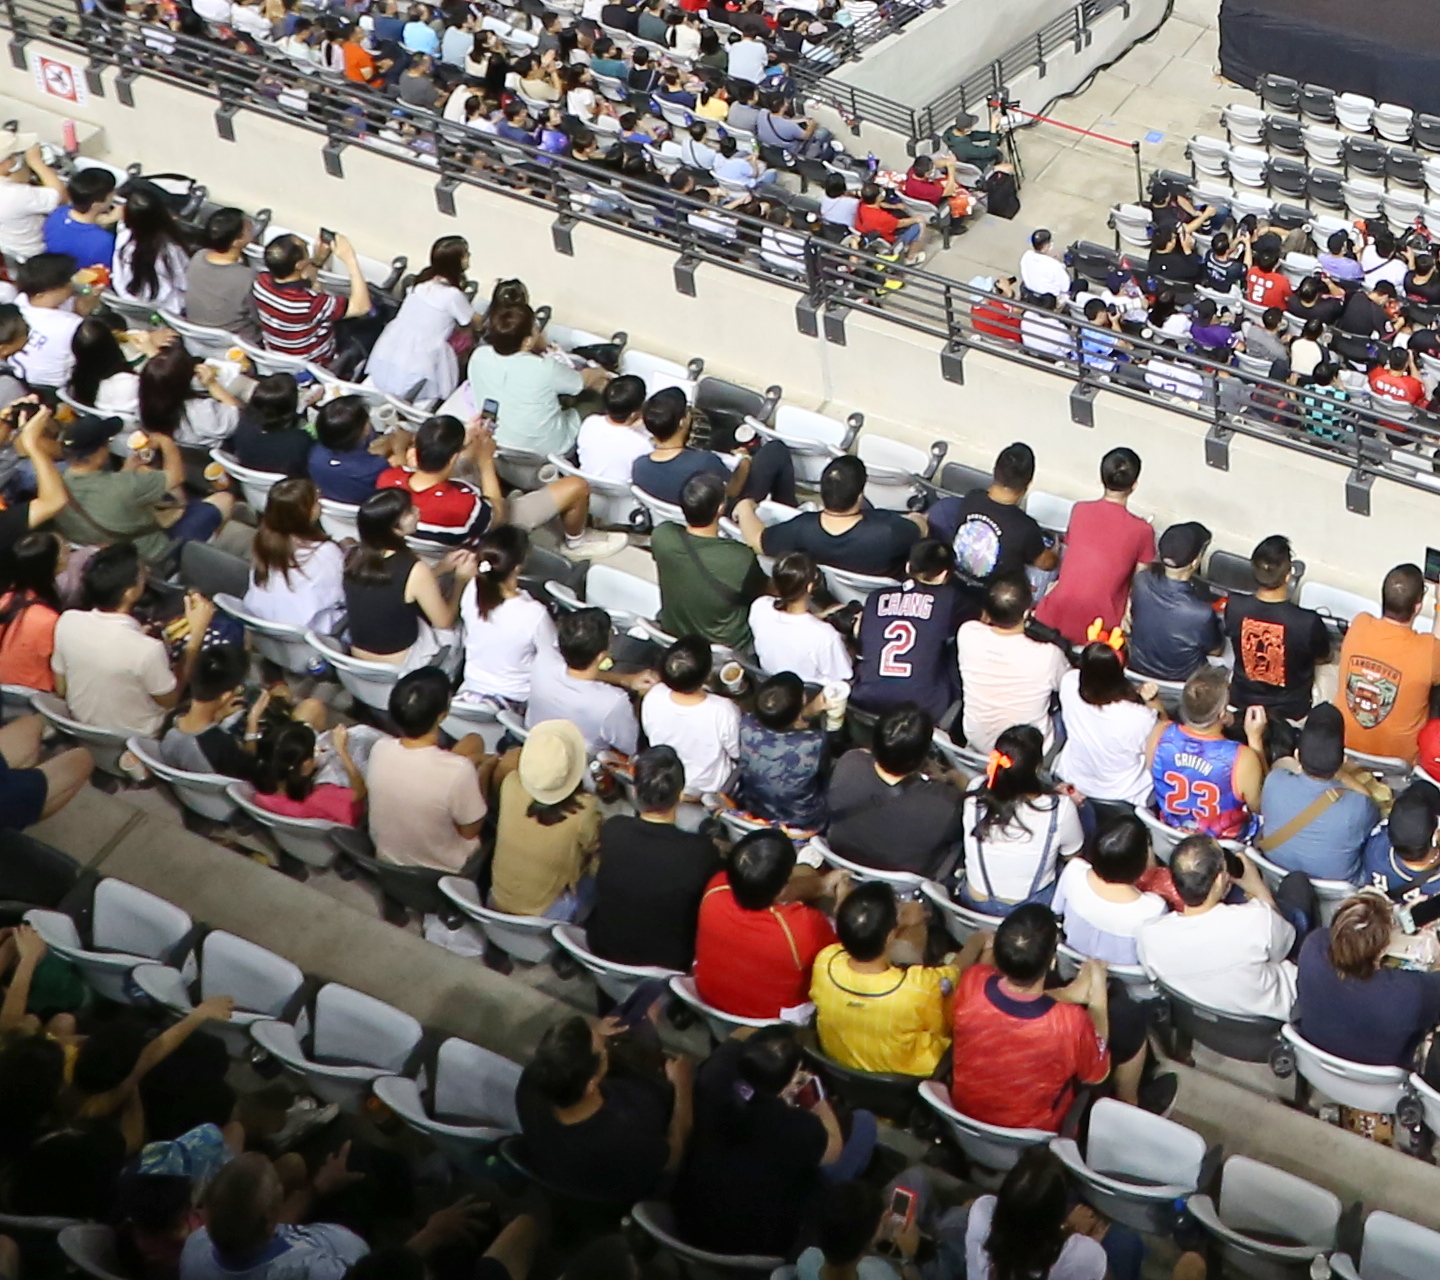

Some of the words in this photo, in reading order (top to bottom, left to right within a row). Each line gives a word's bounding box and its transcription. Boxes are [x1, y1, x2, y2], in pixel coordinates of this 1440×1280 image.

[1251, 284, 1266, 302] 2
[878, 592, 934, 620] CHANG
[879, 620, 916, 677] 2
[1174, 752, 1214, 777] GRIFFIN
[1163, 770, 1220, 822] 23
